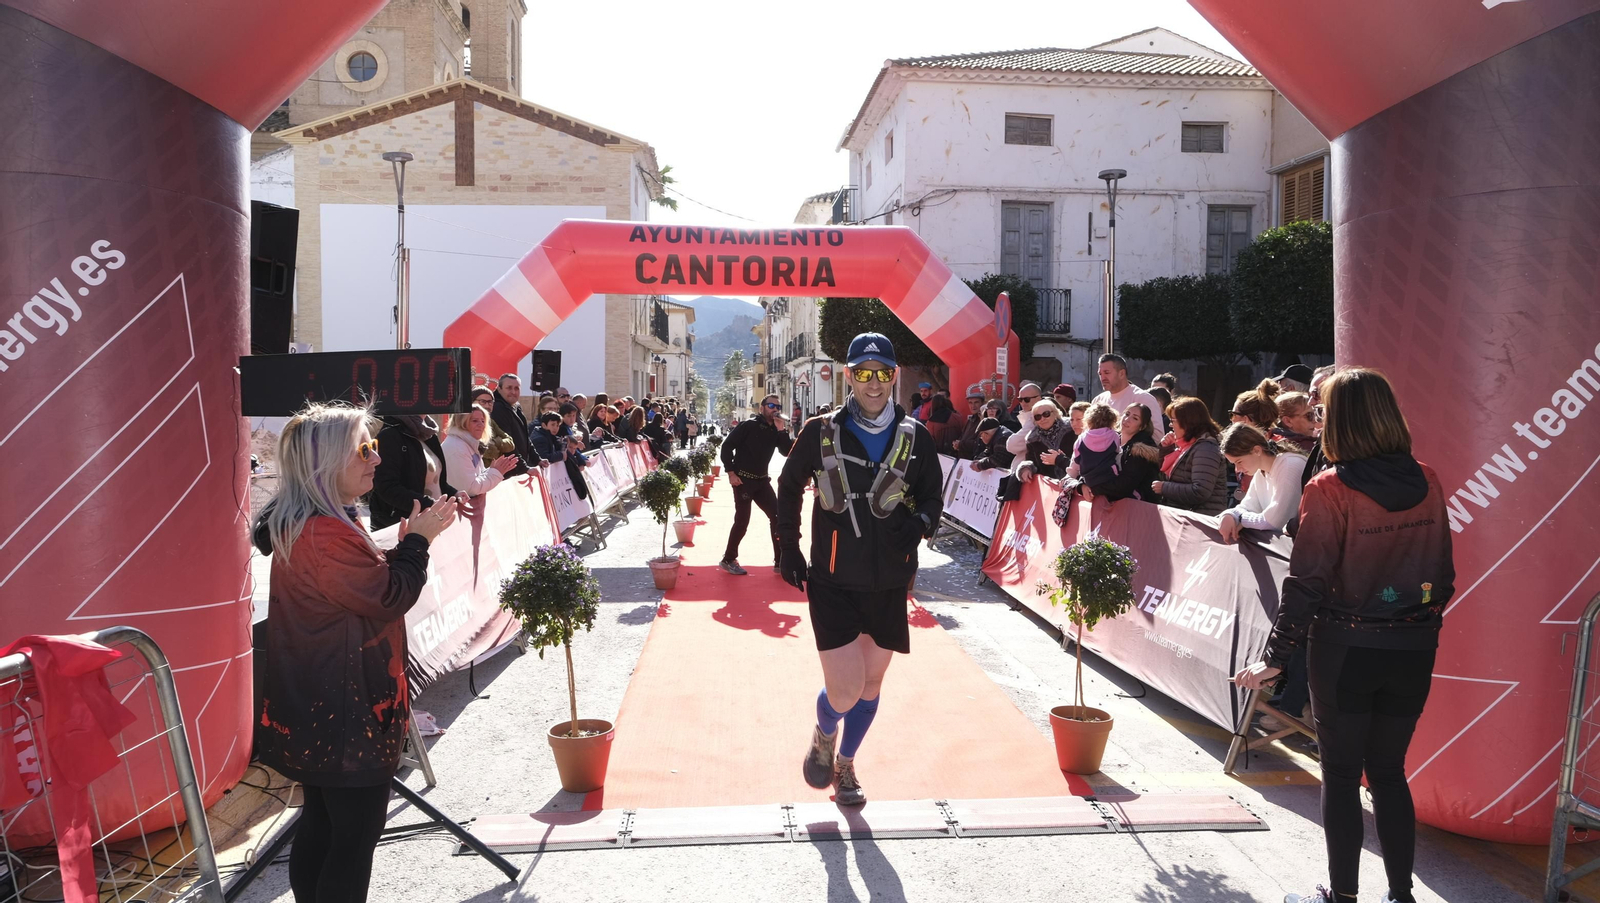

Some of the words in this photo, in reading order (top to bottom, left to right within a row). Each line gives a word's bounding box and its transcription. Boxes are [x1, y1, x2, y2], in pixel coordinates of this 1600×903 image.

[629, 225, 844, 246] AYUNTAMIENTO
[635, 252, 837, 287] CANTORIA
[1358, 527, 1382, 535] VALLE
[1385, 524, 1395, 532] DE
[412, 591, 475, 657] TEAMERGY
[1137, 584, 1237, 640] TEAMERGY
